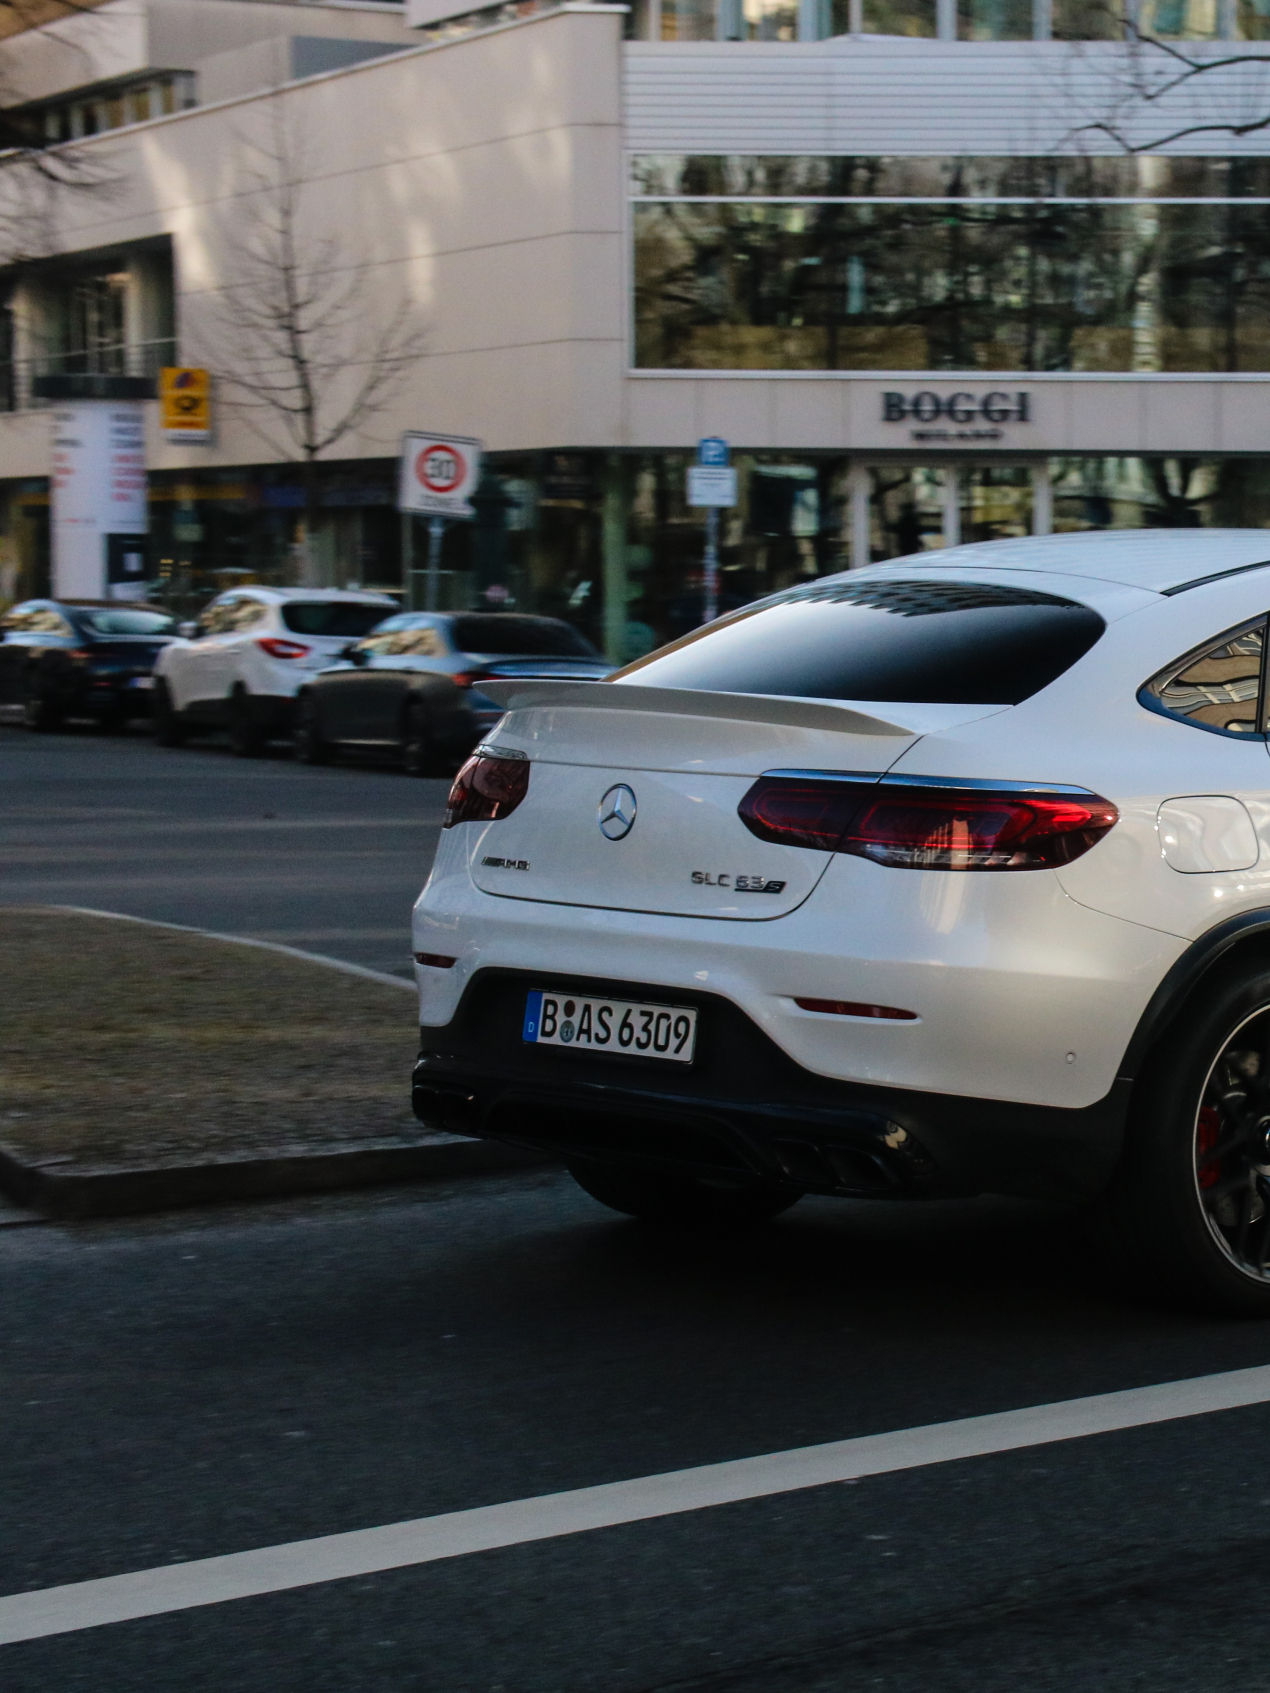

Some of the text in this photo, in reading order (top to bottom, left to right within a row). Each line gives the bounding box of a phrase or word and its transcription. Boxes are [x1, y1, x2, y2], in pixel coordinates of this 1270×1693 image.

[881, 390, 1032, 423] BOGGI
[425, 457, 458, 480] 30
[540, 998, 559, 1038] B
